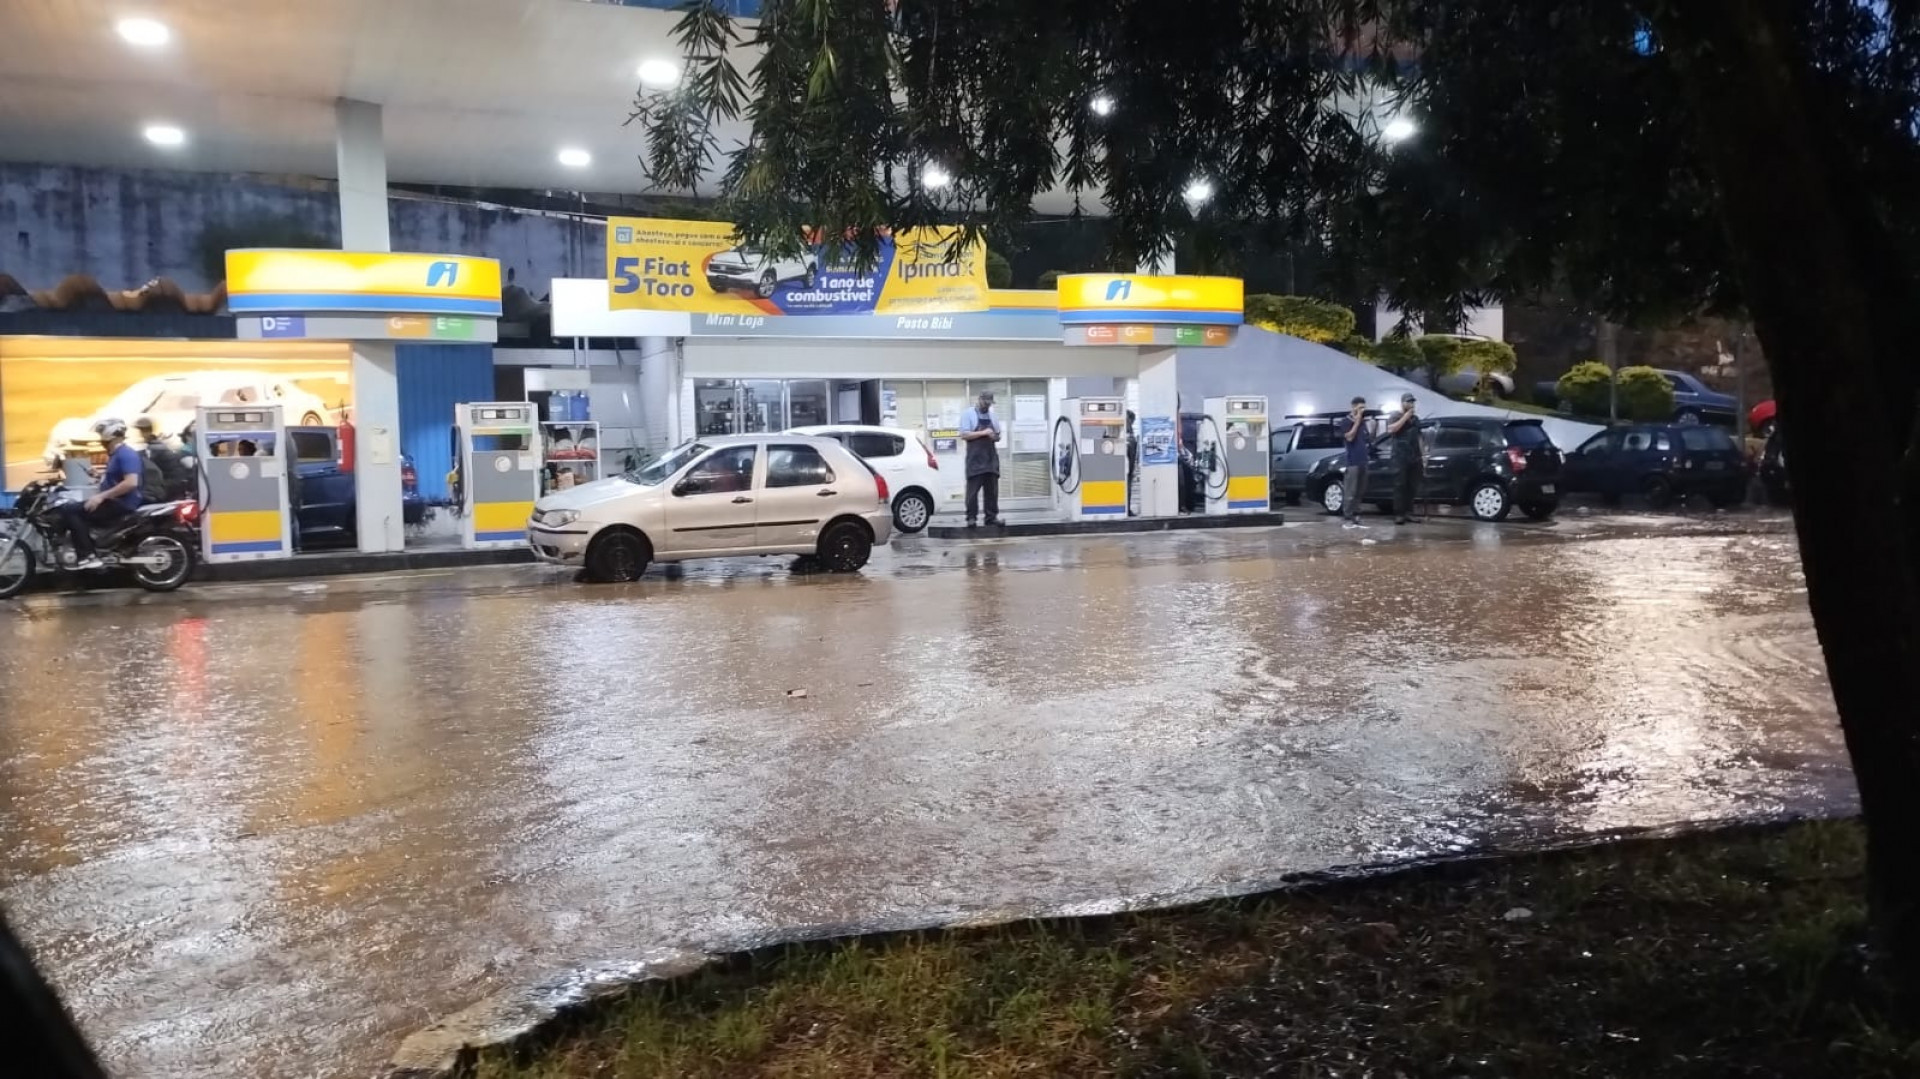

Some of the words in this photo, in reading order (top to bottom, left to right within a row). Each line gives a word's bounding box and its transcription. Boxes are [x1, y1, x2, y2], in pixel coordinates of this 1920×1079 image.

[644, 257, 691, 277] Fiat
[614, 257, 641, 294] 5
[642, 278, 694, 297] Toro
[820, 276, 828, 289] 1
[829, 277, 855, 289] ano
[262, 317, 276, 331] D
[390, 317, 402, 329] G
[437, 317, 447, 330] E
[706, 313, 734, 326] Mini
[738, 315, 764, 329] Loja
[896, 316, 928, 329] Posto
[930, 316, 953, 329] Bibi
[1087, 326, 1097, 337] G
[1125, 326, 1134, 336] G
[1176, 328, 1184, 338] E
[1207, 328, 1215, 338] G
